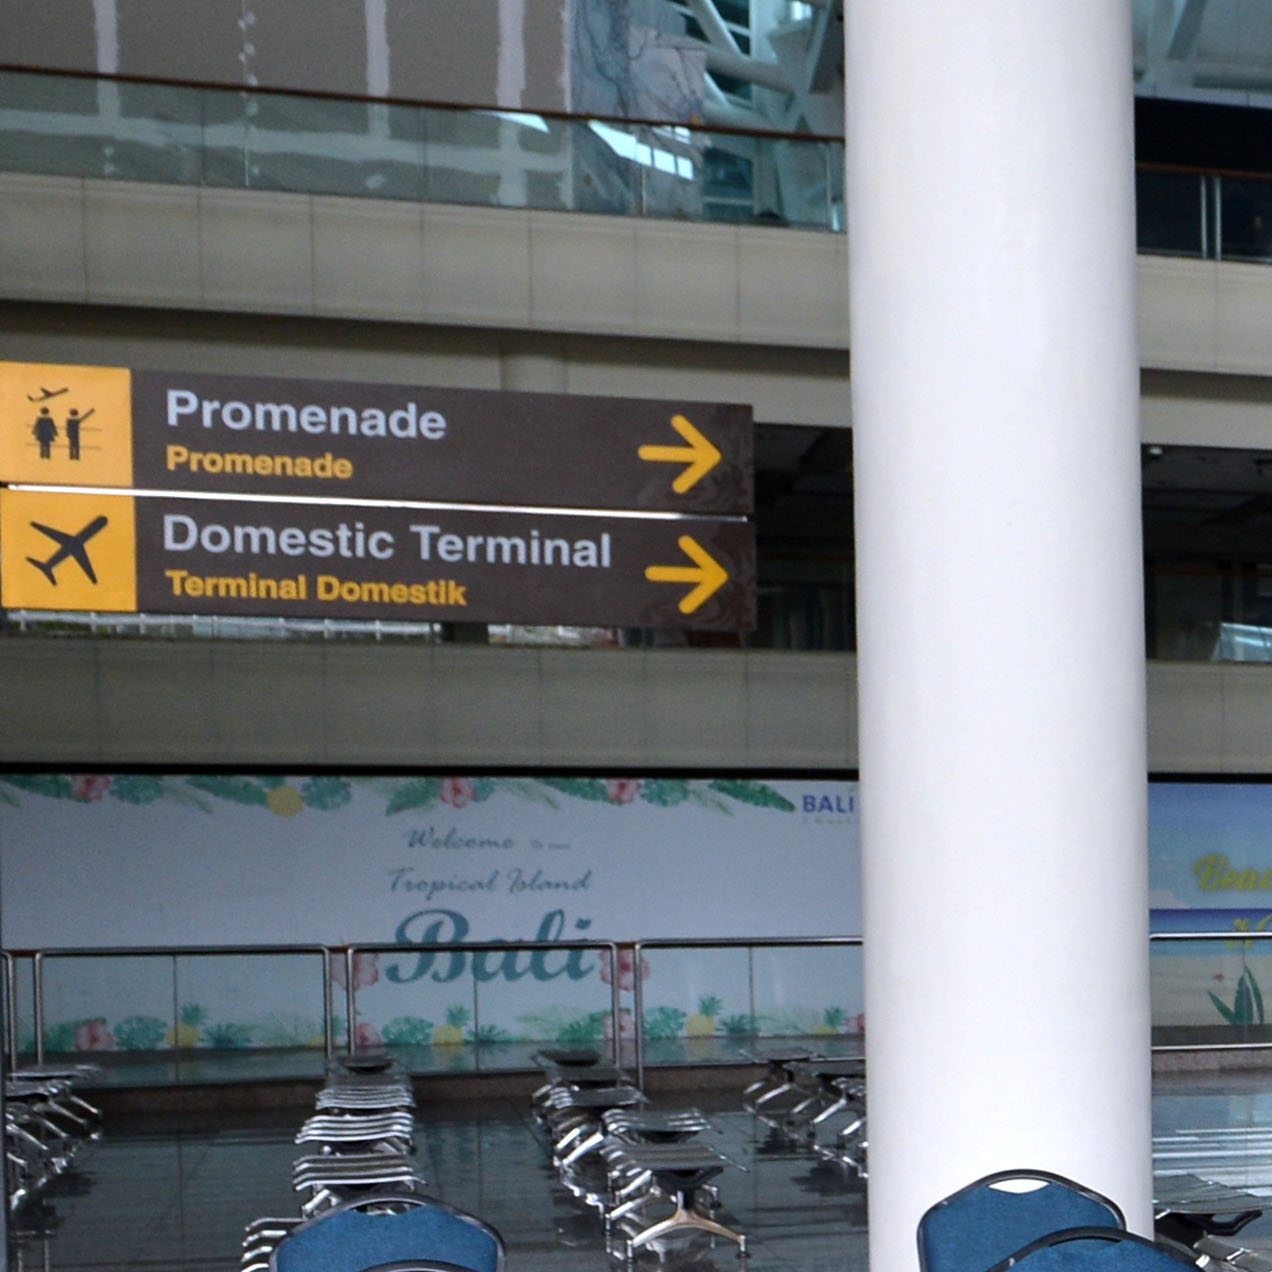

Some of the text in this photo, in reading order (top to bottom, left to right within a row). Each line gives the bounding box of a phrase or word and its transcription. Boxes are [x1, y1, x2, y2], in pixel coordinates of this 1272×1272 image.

[166, 389, 448, 440] Promenade
[165, 445, 354, 479] Promenade
[163, 514, 611, 568] Domestic Terminal
[165, 569, 468, 606] Terminal Domestik
[802, 794, 855, 814] BALI
[404, 826, 516, 849] Welcome
[387, 867, 593, 901] Tropical Island
[385, 908, 595, 983] Bali
